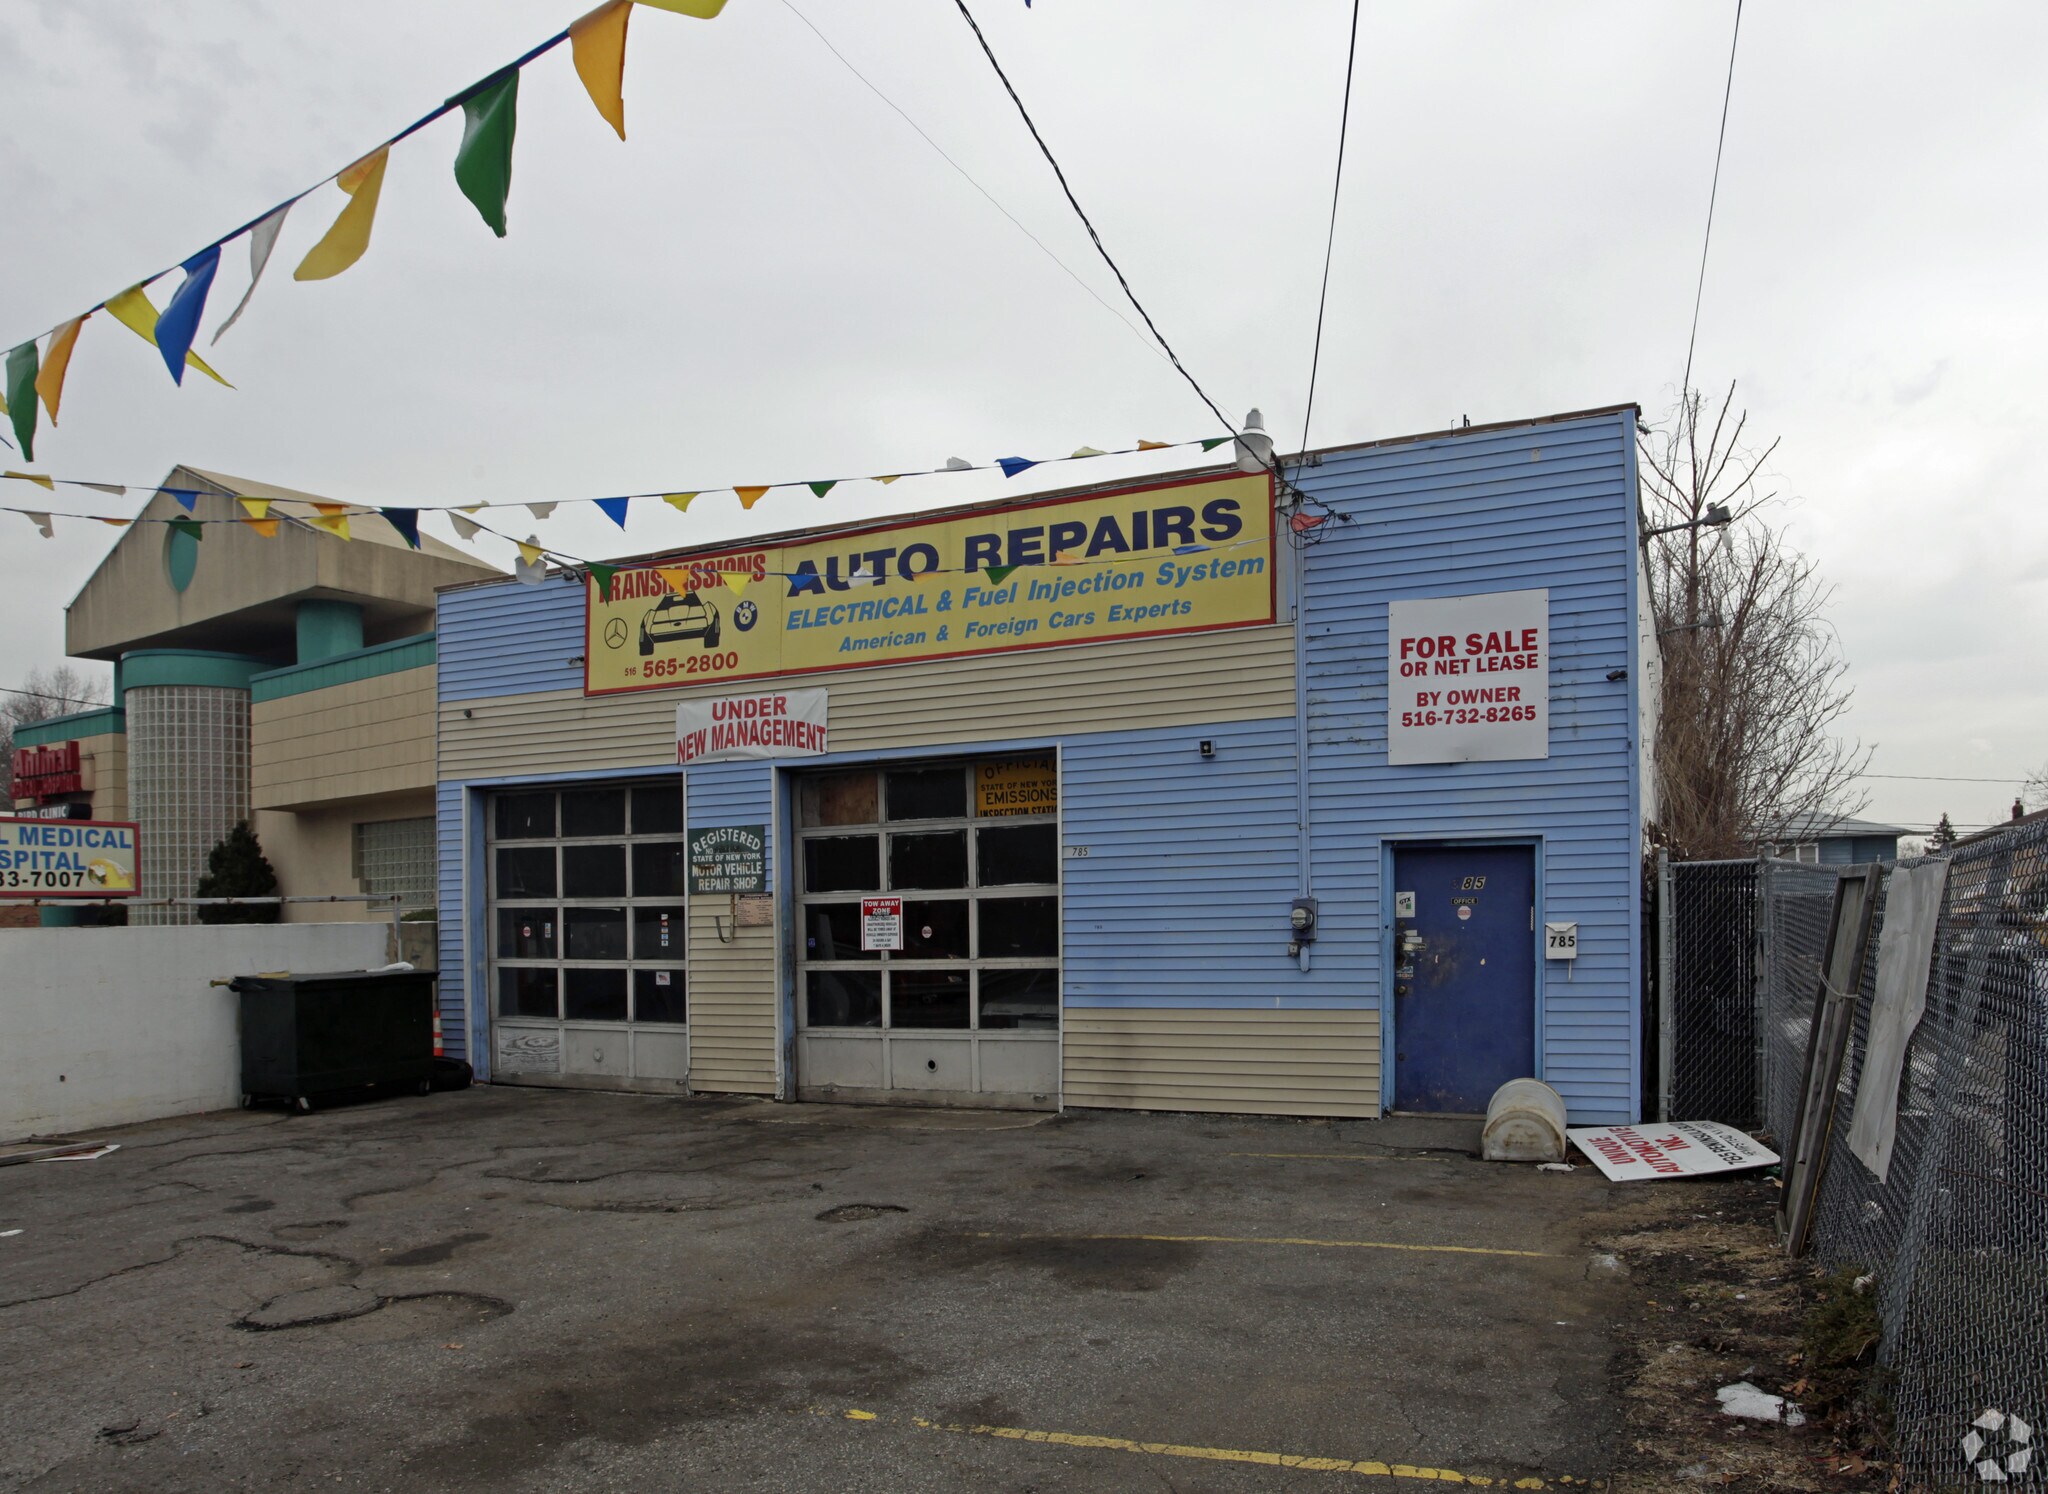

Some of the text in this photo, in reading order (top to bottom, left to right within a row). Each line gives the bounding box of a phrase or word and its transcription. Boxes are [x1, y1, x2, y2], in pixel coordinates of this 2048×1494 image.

[786, 498, 1243, 598] AUTO REPAIRS
[786, 557, 1265, 631] ELECTRICAL & Fuel Injection System
[839, 599, 1192, 653] American & Foreign Cars Experts
[1400, 628, 1538, 660] FOR SALE
[624, 651, 739, 678] 516 565-2800
[1400, 653, 1539, 677] OR NET LEASE
[1416, 686, 1521, 707] BY OWNER
[712, 696, 787, 721] UNDER
[1401, 705, 1536, 727] 516-732-8265
[677, 719, 826, 765] NEW MANAGEMENT
[12, 741, 79, 778] Animal
[981, 783, 1004, 791] STATE
[1041, 779, 1057, 787] YOR
[986, 788, 1057, 805] EMISSIONS
[40, 805, 67, 819] CLINIC
[18, 826, 132, 849] MEDICAL
[691, 828, 761, 855] REGISTERED
[0, 849, 87, 871] SPITAL
[692, 855, 713, 863] STATE
[1072, 847, 1088, 857] 785
[692, 862, 762, 877] MOTOR VEHICLE
[698, 876, 758, 891] REPAIR SHOP
[1549, 936, 1575, 948] 785
[1586, 1137, 1637, 1165] UNIQUE
[1607, 1127, 1685, 1173] AUTOMOTIVE
[1655, 1133, 1692, 1152] INC.
[1717, 1151, 1747, 1166] 785
